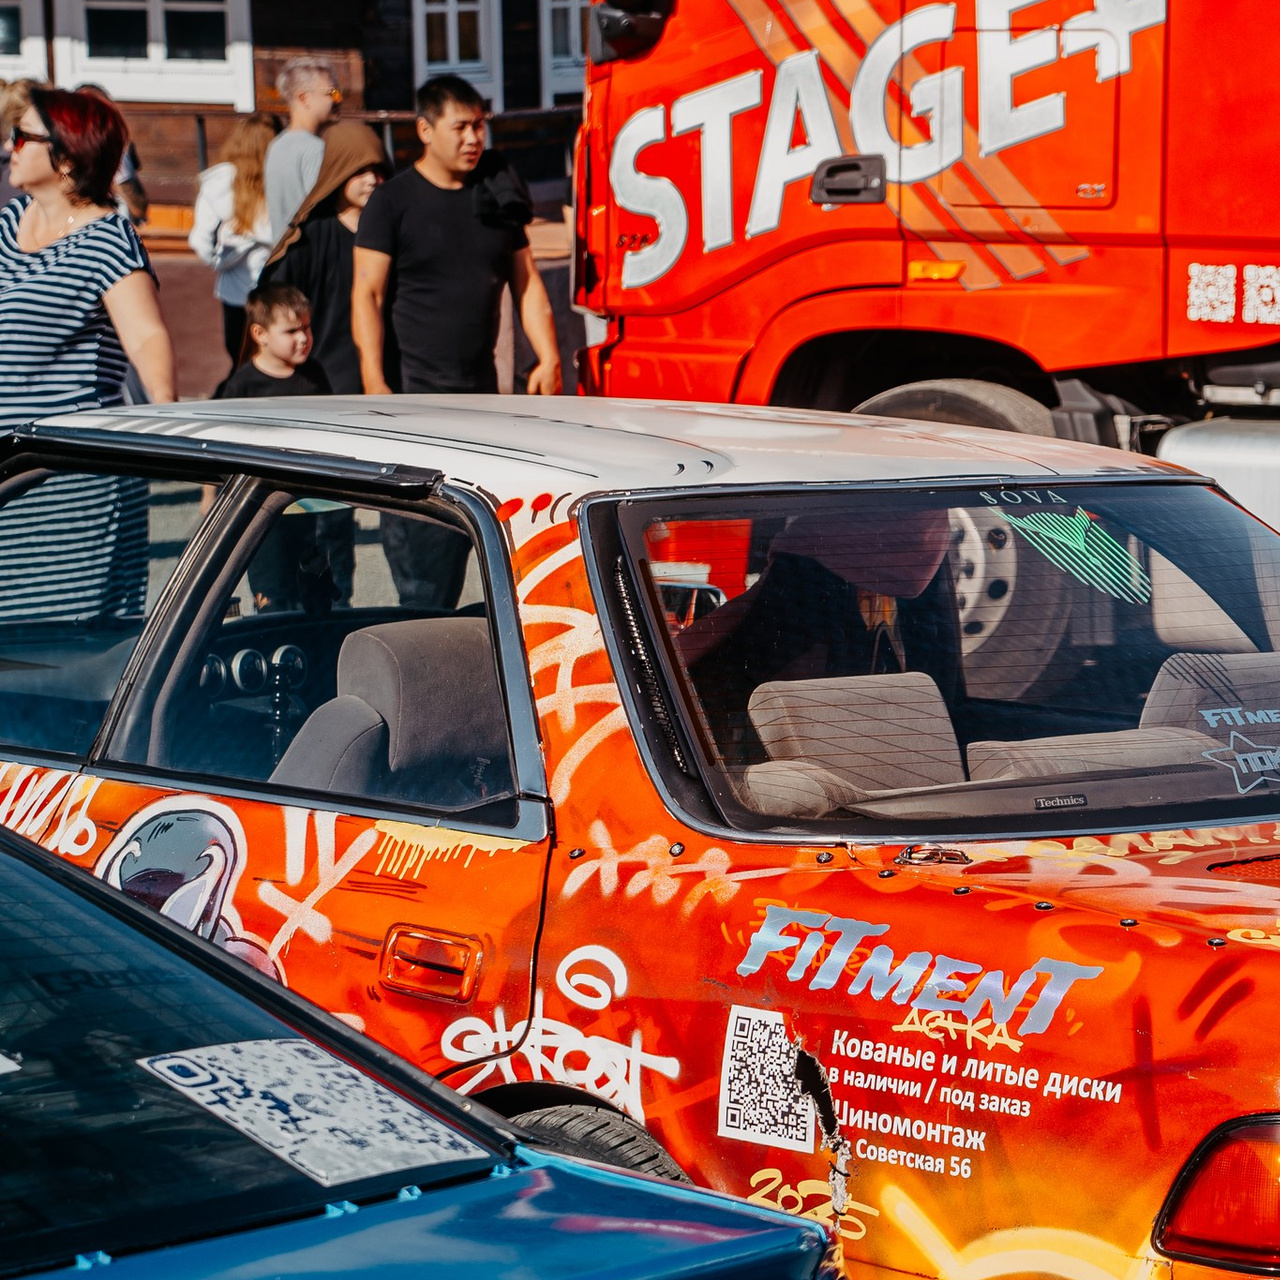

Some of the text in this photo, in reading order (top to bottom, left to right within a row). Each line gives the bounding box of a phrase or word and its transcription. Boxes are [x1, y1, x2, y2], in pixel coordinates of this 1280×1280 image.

[1037, 796, 1085, 807] Technics
[830, 1029, 1123, 1104] Кованые и литые диски
[842, 1070, 922, 1099] наличии
[938, 1086, 976, 1113] под
[977, 1093, 1032, 1119] заказ
[855, 1141, 946, 1175] Советская
[948, 1157, 973, 1180] 56
